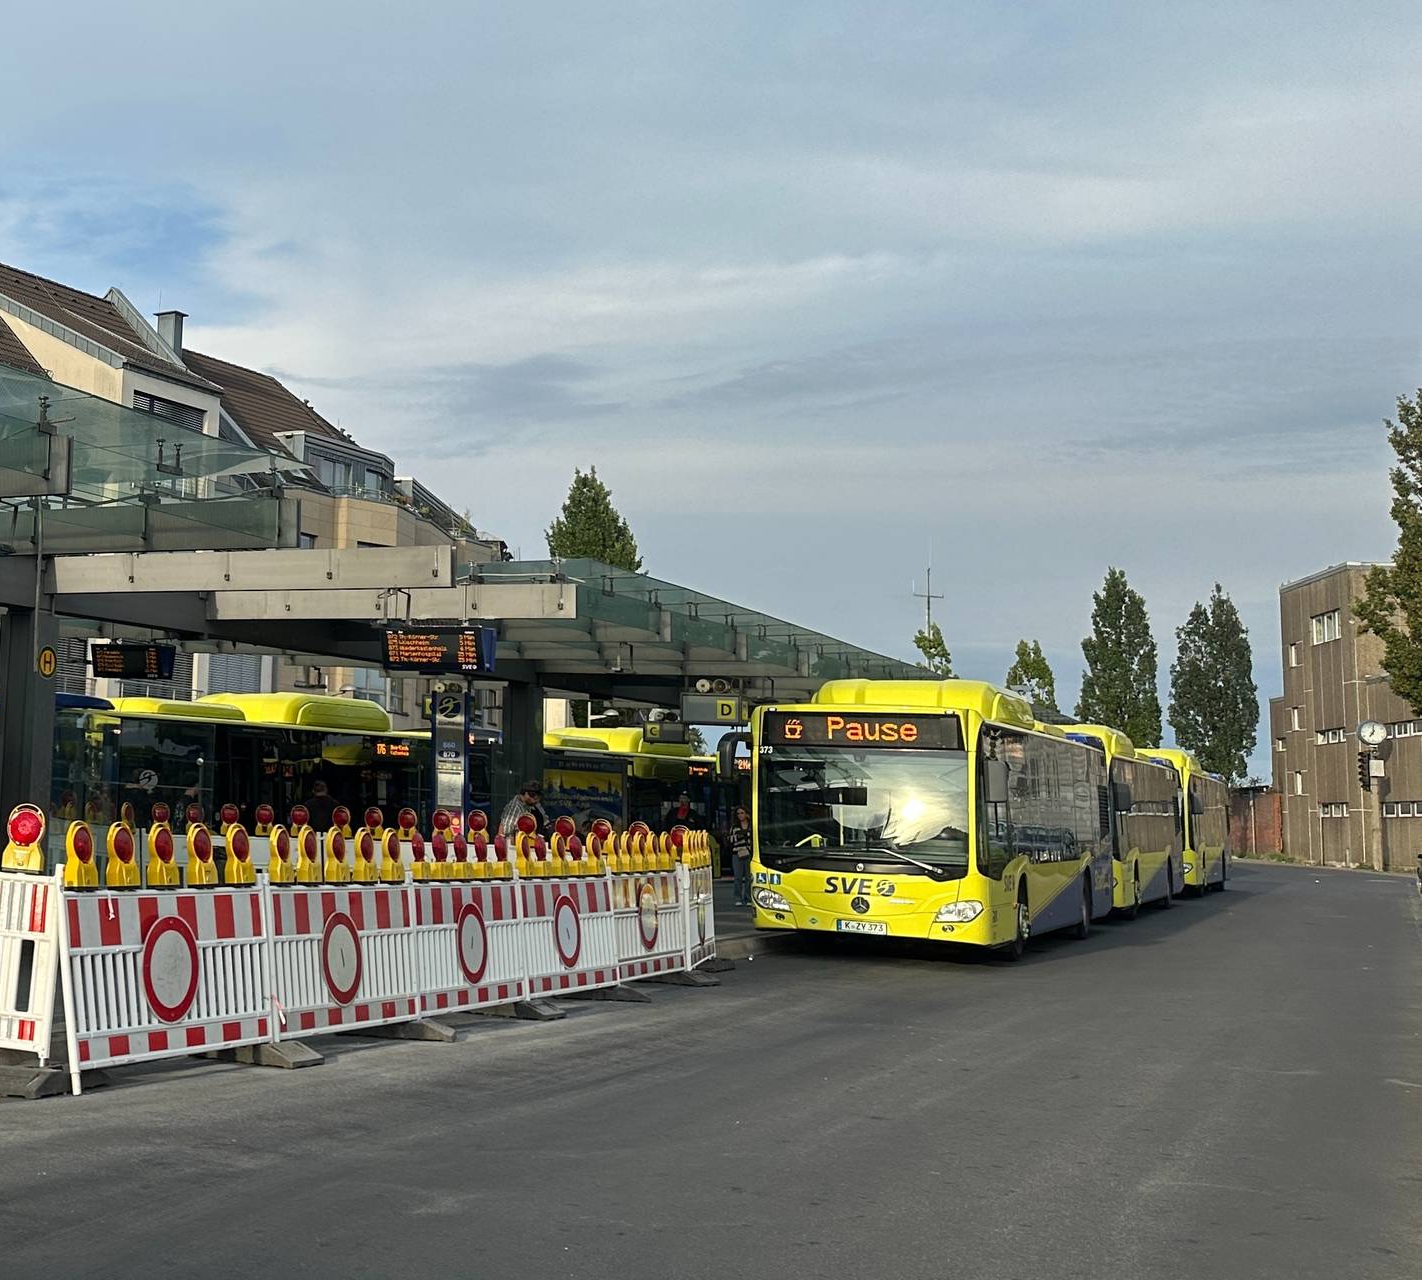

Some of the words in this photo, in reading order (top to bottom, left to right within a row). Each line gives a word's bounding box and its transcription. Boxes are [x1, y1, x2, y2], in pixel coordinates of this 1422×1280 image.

[721, 703, 731, 716] D
[649, 724, 658, 736] C
[827, 716, 919, 742] Pause
[759, 746, 773, 754] 373
[824, 876, 873, 895] SVE
[844, 921, 851, 929] K
[867, 923, 884, 932] 373
